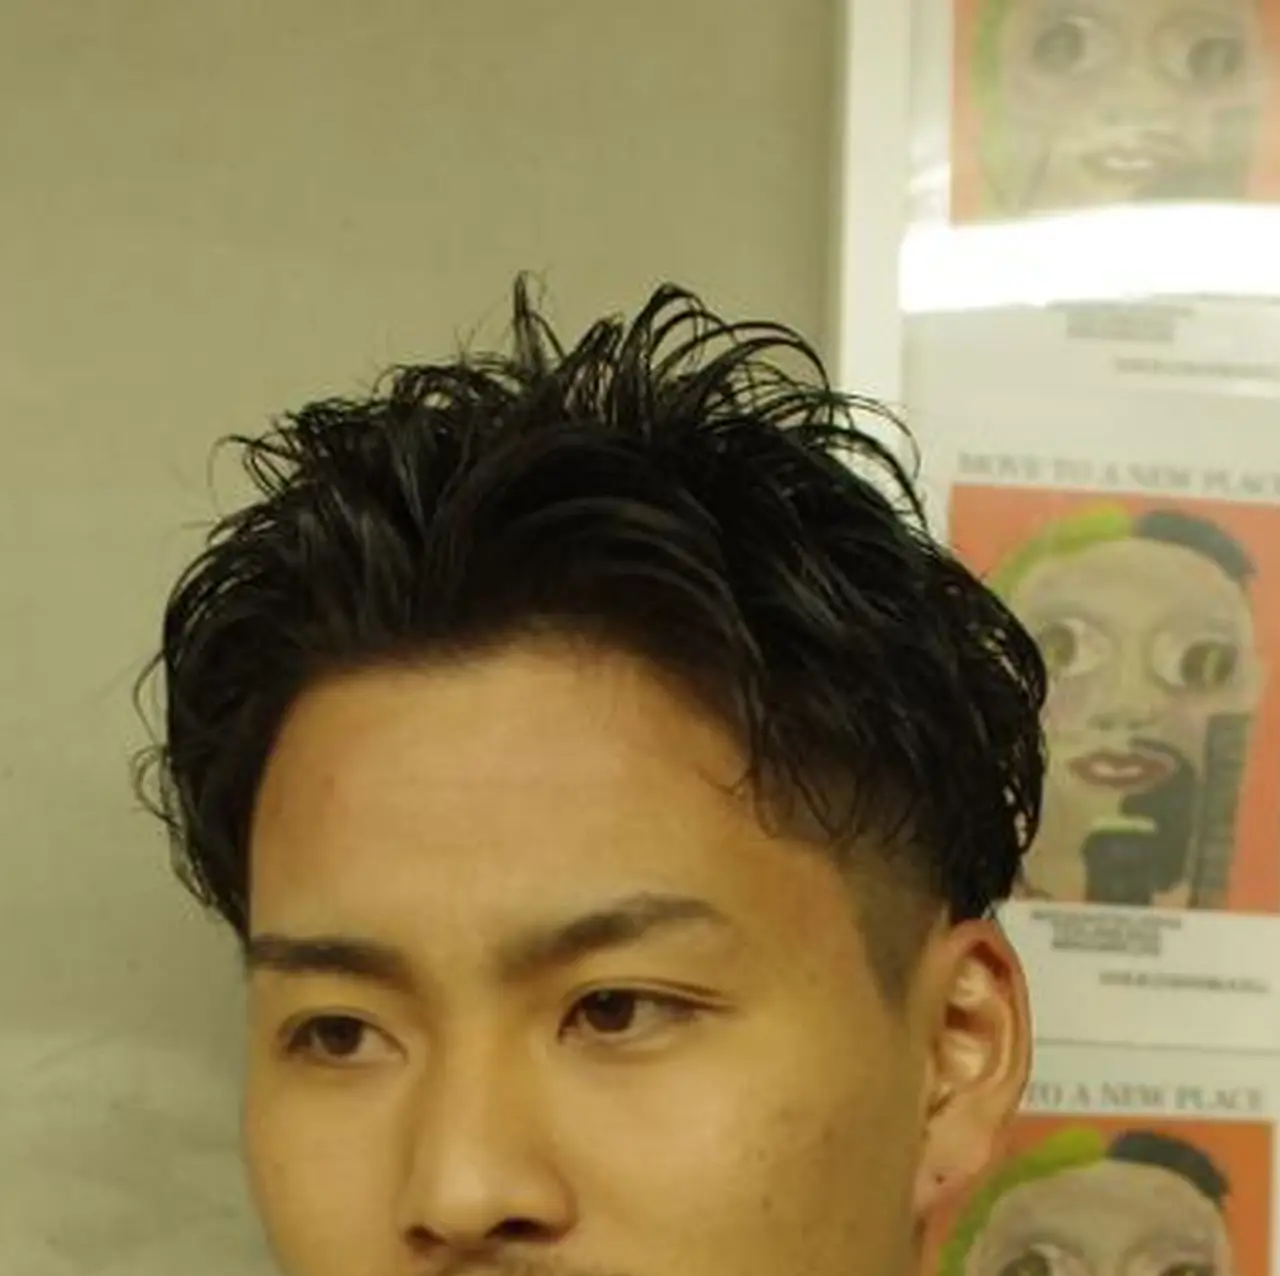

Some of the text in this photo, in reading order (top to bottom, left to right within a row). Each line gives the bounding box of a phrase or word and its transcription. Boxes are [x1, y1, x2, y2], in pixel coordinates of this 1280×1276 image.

[1053, 457, 1094, 483] TO
[1126, 462, 1191, 489] NEW
[1100, 1083, 1164, 1111] NEW
[1174, 1085, 1264, 1114] PLACE
